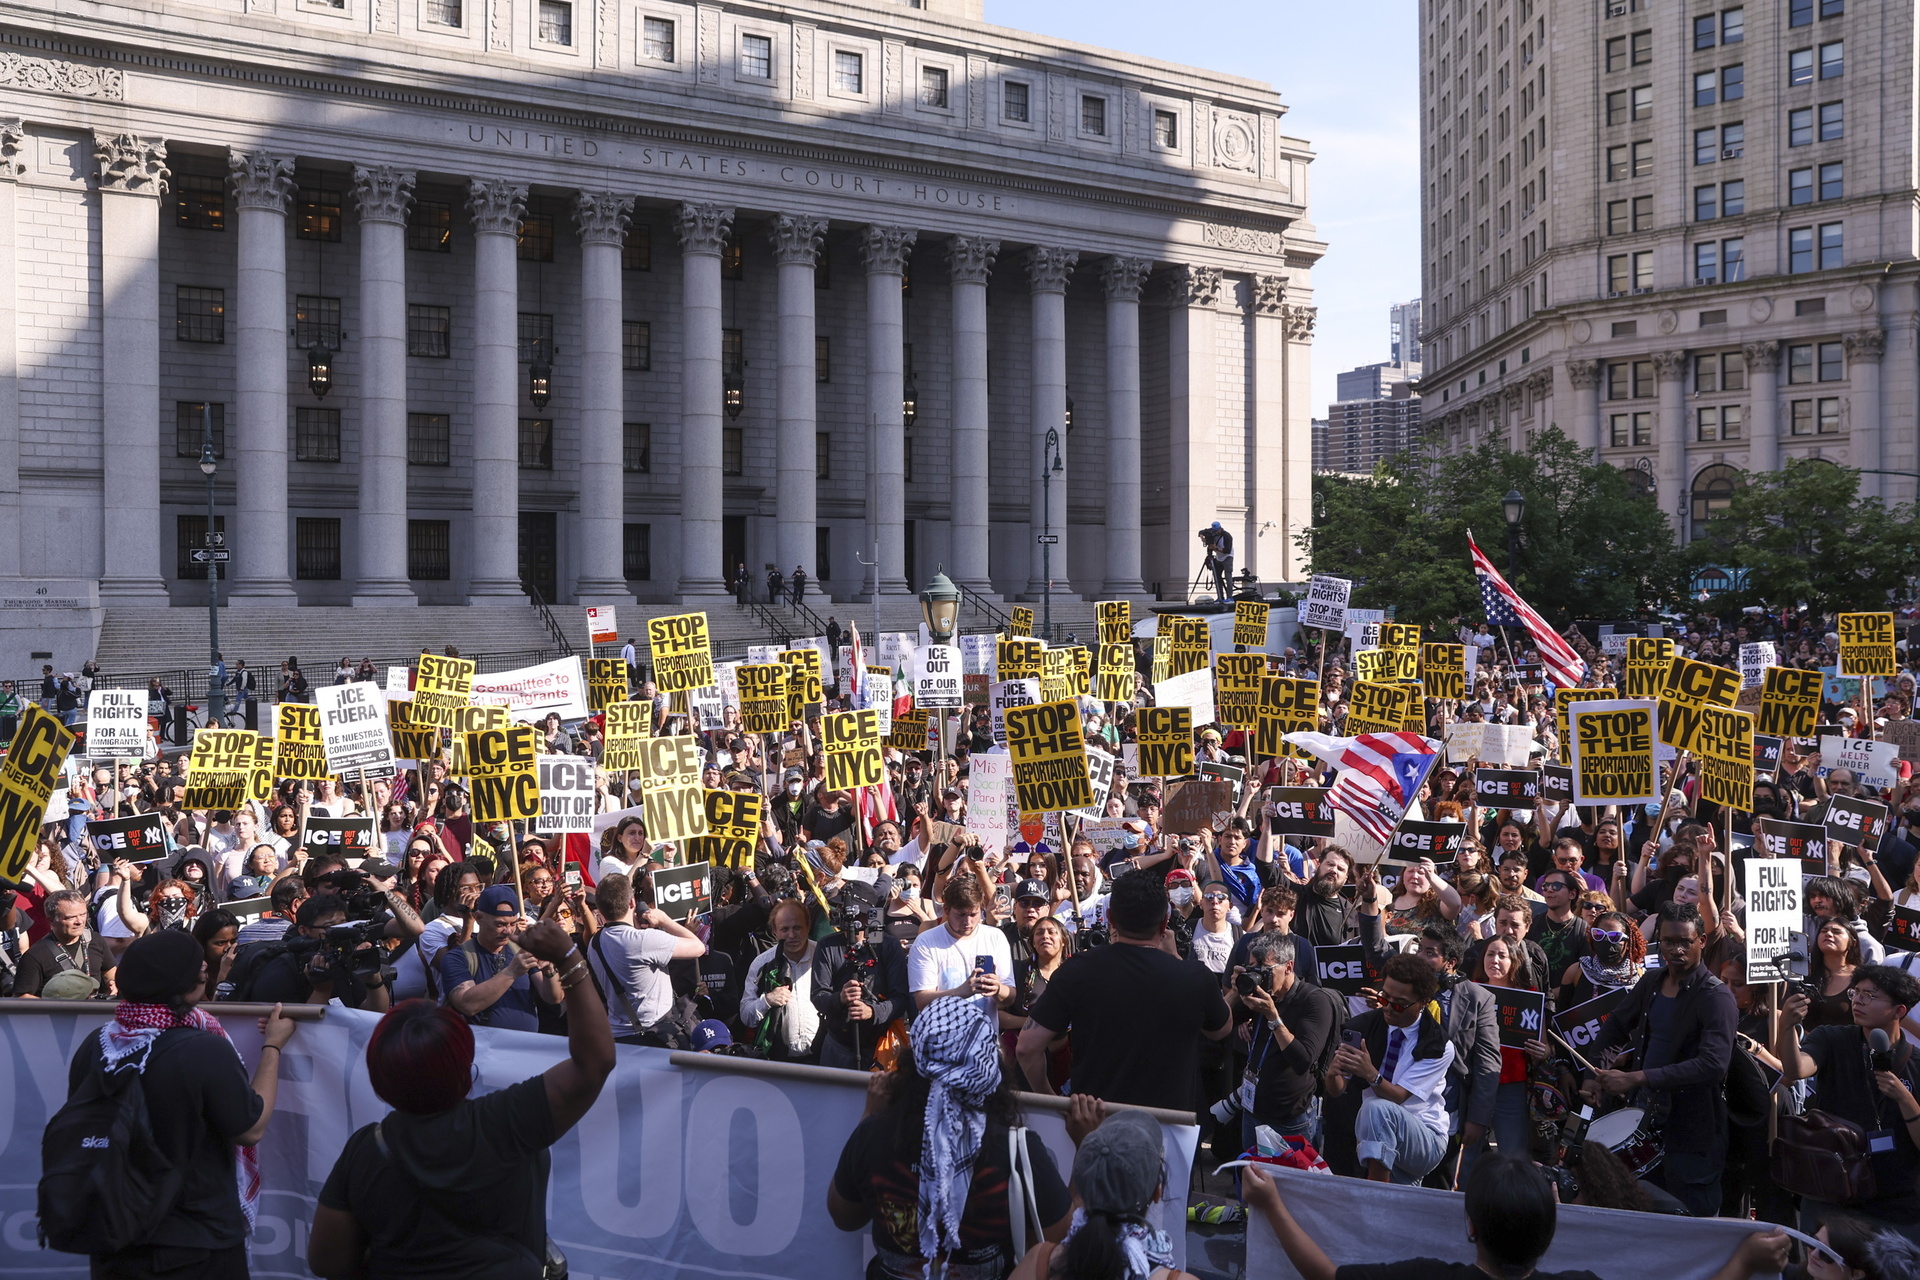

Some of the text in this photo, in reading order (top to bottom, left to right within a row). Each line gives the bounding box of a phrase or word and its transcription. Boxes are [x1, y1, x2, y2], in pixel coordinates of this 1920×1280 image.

[468, 125, 1002, 211] UNITED STATES COURT HOUSE
[36, 587, 47, 595] 40
[1312, 589, 1346, 603] RIGHTS!
[1012, 608, 1032, 622] ICE
[1100, 602, 1129, 618] ICE
[1237, 603, 1268, 616] STOP
[1309, 603, 1329, 614] STOP
[1331, 607, 1343, 617] THE
[1350, 610, 1378, 619] ICE OUT
[650, 616, 704, 640] STOP
[1236, 614, 1267, 624] THE
[1840, 615, 1890, 632] STOP
[1100, 622, 1130, 644] NYC
[1175, 624, 1208, 643] ICE
[1234, 624, 1266, 635] DEPORTATIONS
[1234, 632, 1265, 645] NOW!
[1363, 626, 1377, 635] ICE
[1380, 625, 1418, 646] ICE
[1841, 632, 1892, 643] THE
[652, 635, 707, 654] THE
[1361, 636, 1379, 645] OUT
[928, 648, 948, 660] ICE
[998, 642, 1041, 663] ICE
[1100, 644, 1134, 666] ICE
[1425, 645, 1463, 665] ICE
[1629, 639, 1673, 661] ICE
[1842, 646, 1893, 659] DEPORTATIONS
[420, 657, 473, 680] STOP
[656, 652, 709, 672] DEPORTATIONS
[927, 660, 950, 673] OUT
[1218, 656, 1264, 675] STOP
[1358, 651, 1394, 669] STOP
[1742, 654, 1773, 665] RIGHTS!
[1842, 659, 1893, 675] NOW!
[590, 660, 625, 678] ICE
[738, 666, 783, 686] STOP
[1359, 666, 1396, 680] THE
[1742, 668, 1761, 678] STOP
[419, 676, 470, 693] THE
[476, 674, 570, 693] Committee to
[658, 669, 713, 691] NOW!
[920, 678, 957, 689] OF OUR
[1098, 673, 1133, 700] NYC
[1426, 672, 1464, 698] NYC
[1667, 660, 1739, 706] ICE
[1767, 668, 1821, 697] ICE
[102, 694, 135, 706] FULL
[591, 685, 626, 709] NYC
[738, 684, 784, 698] THE
[1261, 678, 1316, 712] ICE
[1353, 683, 1405, 709] STOP
[1763, 692, 1796, 701] OUT
[416, 692, 467, 709] DEPORTATIONS
[741, 699, 785, 714] DEPORTATIONS
[996, 697, 1034, 708] FUERA
[93, 707, 142, 719] RIGHTS
[328, 705, 378, 725] FUERA
[607, 704, 650, 722] STOP
[1006, 703, 1076, 739] STOP
[1139, 708, 1191, 734] ICE
[1259, 706, 1316, 718] OUT OF
[1351, 701, 1402, 724] THE
[1759, 701, 1816, 737] NYC
[607, 721, 649, 734] THE
[743, 713, 787, 732] NOW!
[824, 710, 877, 743] ICE
[1579, 712, 1648, 738] STOP
[1702, 709, 1750, 741] STOP
[95, 728, 139, 737] FOR ALL
[328, 729, 383, 745] DE NUESTRAS
[8, 706, 71, 790] ICE
[196, 732, 255, 753] STOP
[329, 739, 386, 754] COMUNIDADES!
[392, 731, 441, 759] NYC
[468, 729, 533, 765] ICE
[825, 738, 878, 751] OUT OF
[1010, 732, 1081, 757] THE
[1580, 735, 1650, 754] THE
[1702, 734, 1750, 760] THE
[1843, 740, 1874, 752] ICE
[193, 754, 251, 768] THE
[641, 738, 697, 778] ICE
[1140, 743, 1192, 775] NYC
[1582, 755, 1650, 773] DEPORTATIONS
[1837, 759, 1870, 770] UNDER
[1841, 752, 1870, 760] MELTS
[469, 762, 534, 776] OUT OF
[827, 748, 881, 790] NYC
[973, 759, 996, 774] Mis
[1014, 756, 1085, 784] DEPORTATIONS
[1703, 755, 1750, 785] DEPORTATIONS
[189, 771, 247, 788] DEPORTATIONS
[540, 763, 593, 791] ICE
[642, 774, 698, 789] OUT OF
[1545, 776, 1569, 791] ICE
[1582, 773, 1651, 795] NOW!
[974, 790, 994, 802] Para
[1018, 778, 1092, 812] NOW!
[1477, 780, 1508, 795] ICE
[1703, 775, 1750, 809] NOW!
[184, 788, 245, 809] NOW!
[472, 774, 539, 820] NYC
[541, 797, 592, 815] OUT OF
[644, 787, 704, 841] NYC
[970, 803, 996, 817] Ahora
[1827, 808, 1862, 830] ICE
[539, 816, 592, 829] NEW YORK
[967, 817, 1003, 829] Para Sus
[305, 830, 341, 845] ICE
[732, 827, 755, 837] OF
[1394, 832, 1432, 850] ICE
[1434, 835, 1446, 843] OUT
[1789, 838, 1802, 847] OUT
[1759, 866, 1787, 887] FULL
[657, 881, 693, 905] ICE
[1751, 889, 1797, 912] RIGHTS
[1754, 928, 1776, 944] FOR
[1319, 961, 1363, 979] ICE
[1502, 1006, 1517, 1016] OUT
[1504, 1016, 1514, 1026] OF
[1563, 1018, 1601, 1049] ICE
